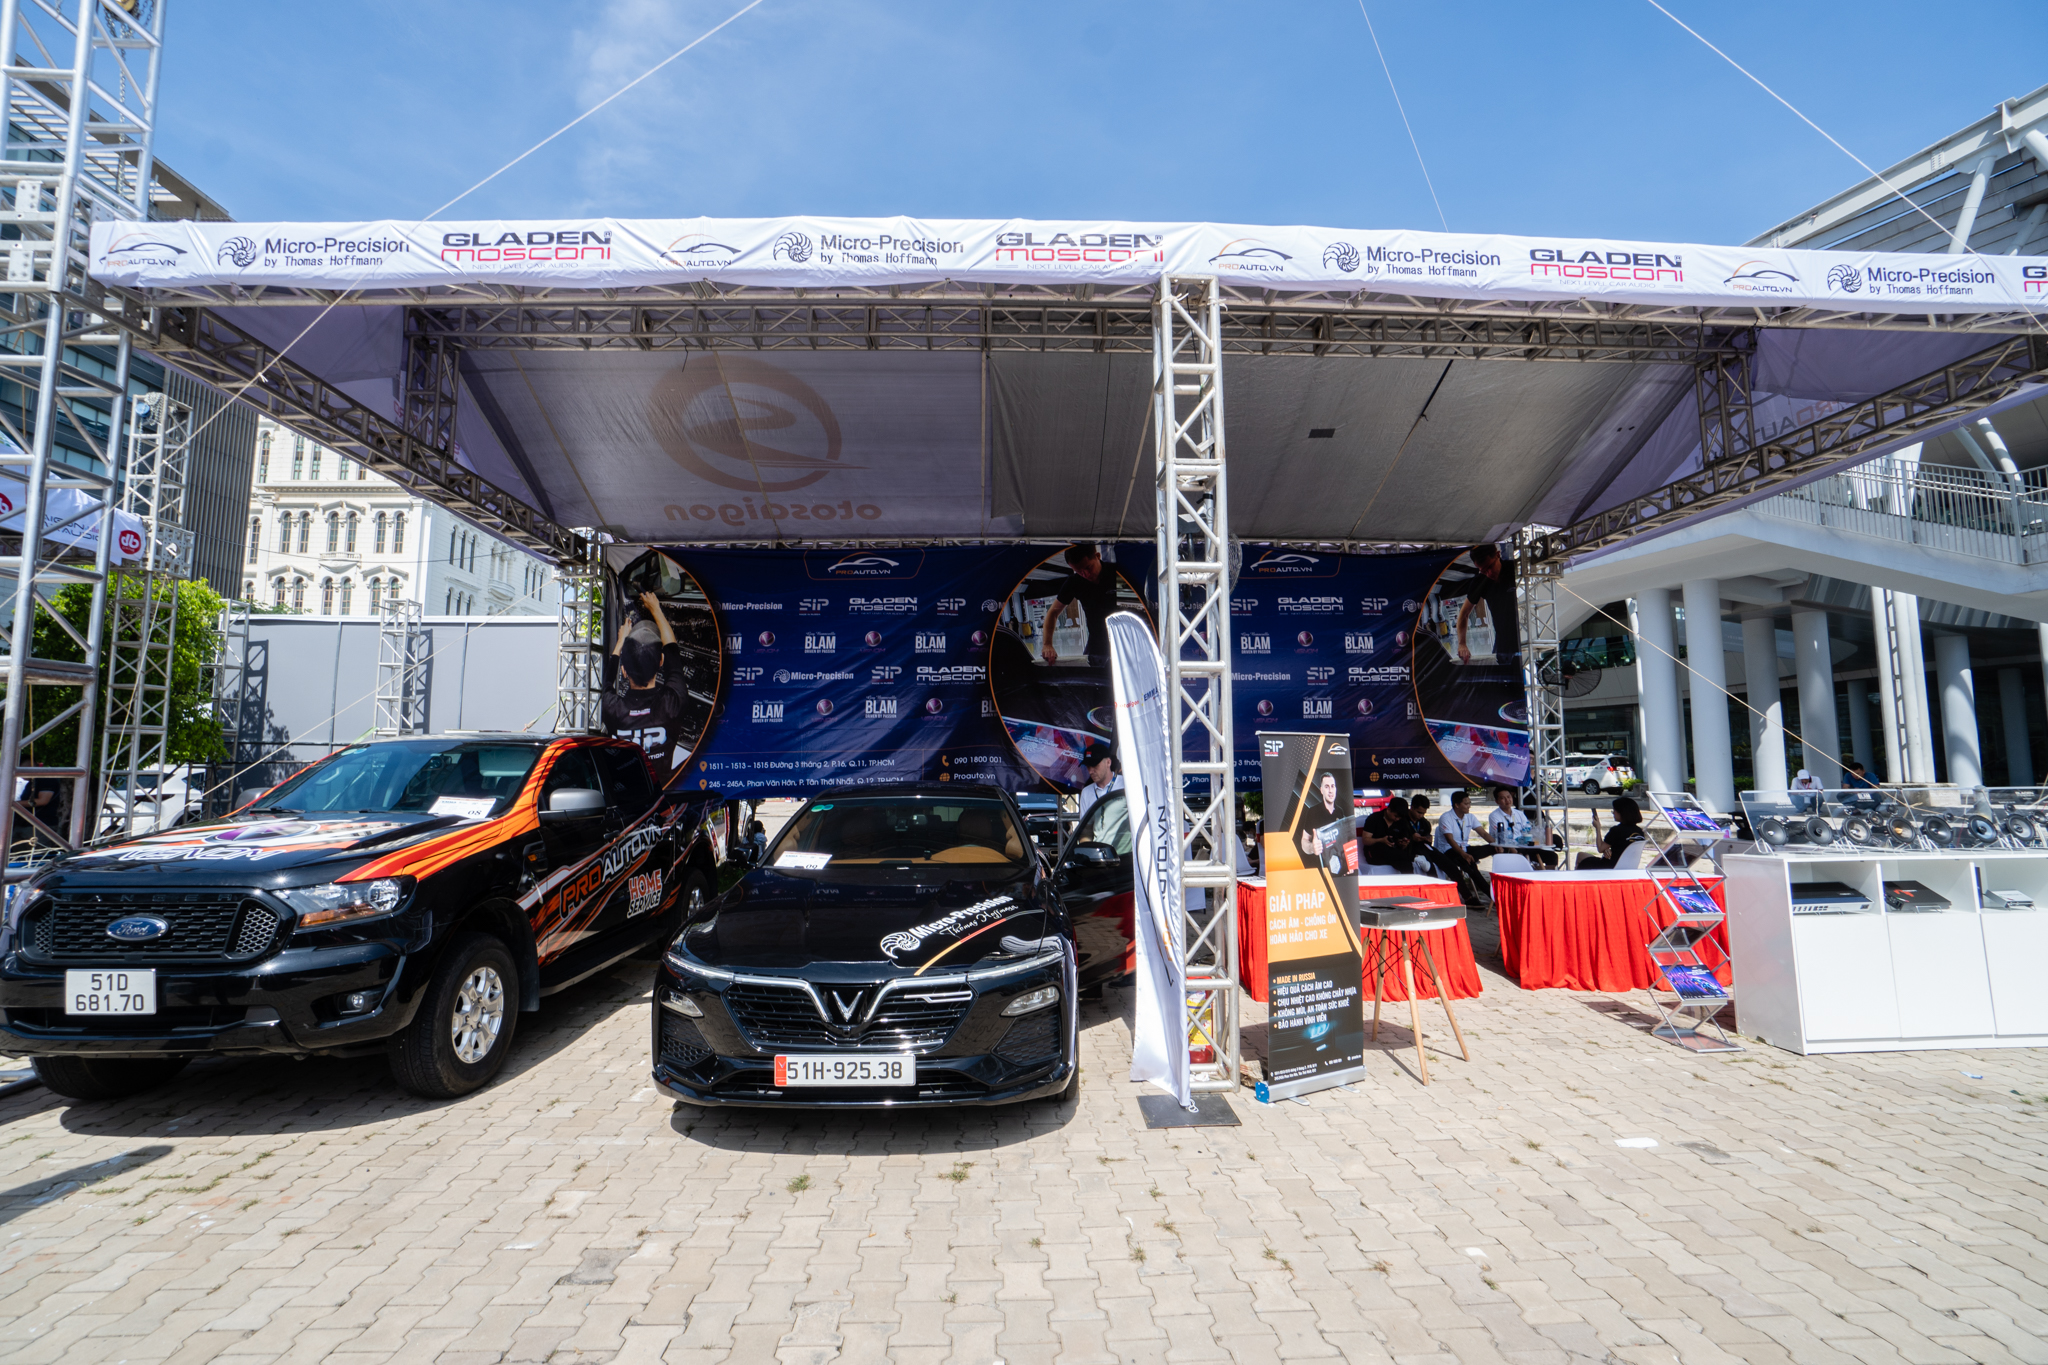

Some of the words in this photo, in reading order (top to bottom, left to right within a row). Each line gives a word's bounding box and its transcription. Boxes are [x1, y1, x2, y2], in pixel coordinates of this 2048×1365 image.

[442, 231, 611, 246] GLADEN
[820, 235, 964, 253] Micro-Precision
[996, 233, 1162, 248] GLADEN
[265, 237, 410, 254] Micro-Precision
[264, 257, 277, 268] by
[285, 256, 323, 266] Thomas
[330, 255, 383, 266] Hoffmann
[820, 254, 833, 265] by
[841, 253, 880, 264] Thomas
[886, 253, 938, 266] Hoffmann
[1367, 246, 1501, 266] Micro-Precision
[1530, 249, 1682, 268] GLADEN
[1219, 263, 1284, 272] PROAUTO.VN
[1368, 264, 1379, 275] by
[1386, 263, 1423, 275] Thomas
[1429, 265, 1477, 277] Hoffmann
[1868, 267, 1995, 284] Micro-Precision
[1733, 284, 1792, 293] PROAUTO.VN
[1869, 284, 1881, 295] by
[1886, 284, 1921, 295] Thomas
[1926, 284, 1973, 295] Hoffmann
[721, 602, 783, 611] Micro-Precision
[849, 597, 918, 605] GLADEN
[805, 636, 836, 649] BLAM
[915, 636, 946, 649] BLAM
[1241, 636, 1271, 650] BLAM
[1345, 636, 1373, 650] BLAM
[791, 671, 854, 681] Micro-Precision
[916, 666, 986, 674] GLADEN
[1232, 672, 1291, 680] Micro-Precision
[1348, 666, 1410, 674] GLADEN
[752, 704, 784, 718] BLAM
[865, 700, 897, 713] BLAM
[1303, 700, 1332, 714] BLAM
[753, 761, 768, 769] 1515
[801, 761, 821, 769] tháng
[989, 756, 1002, 764] 001
[954, 772, 996, 780] Proauto.vn
[766, 779, 780, 787] Văn
[562, 825, 662, 913] PROAUTO.VN
[629, 869, 662, 900] HOME
[627, 890, 661, 918] SERVICE
[1269, 889, 1291, 913] GIẢI
[1296, 889, 1325, 910] PHÁP
[909, 896, 1014, 939] Micro-Precision
[1269, 918, 1286, 930] CÁCH
[116, 921, 150, 936] Ford
[1269, 932, 1287, 945] HOÀN
[1289, 930, 1303, 942] HẢO
[1305, 930, 1318, 941] CHO
[1319, 929, 1328, 939] XE
[91, 973, 128, 991] 51D
[1276, 975, 1291, 984] MADE
[1292, 974, 1298, 982] IN
[1298, 972, 1316, 981] RUSSIA
[1300, 983, 1314, 993] CÁCH
[1322, 980, 1333, 989] CAO
[75, 994, 144, 1012] 681.70
[1305, 994, 1315, 1003] CAO
[1307, 1005, 1315, 1013] AN
[787, 1061, 903, 1080] 51H-925.38
